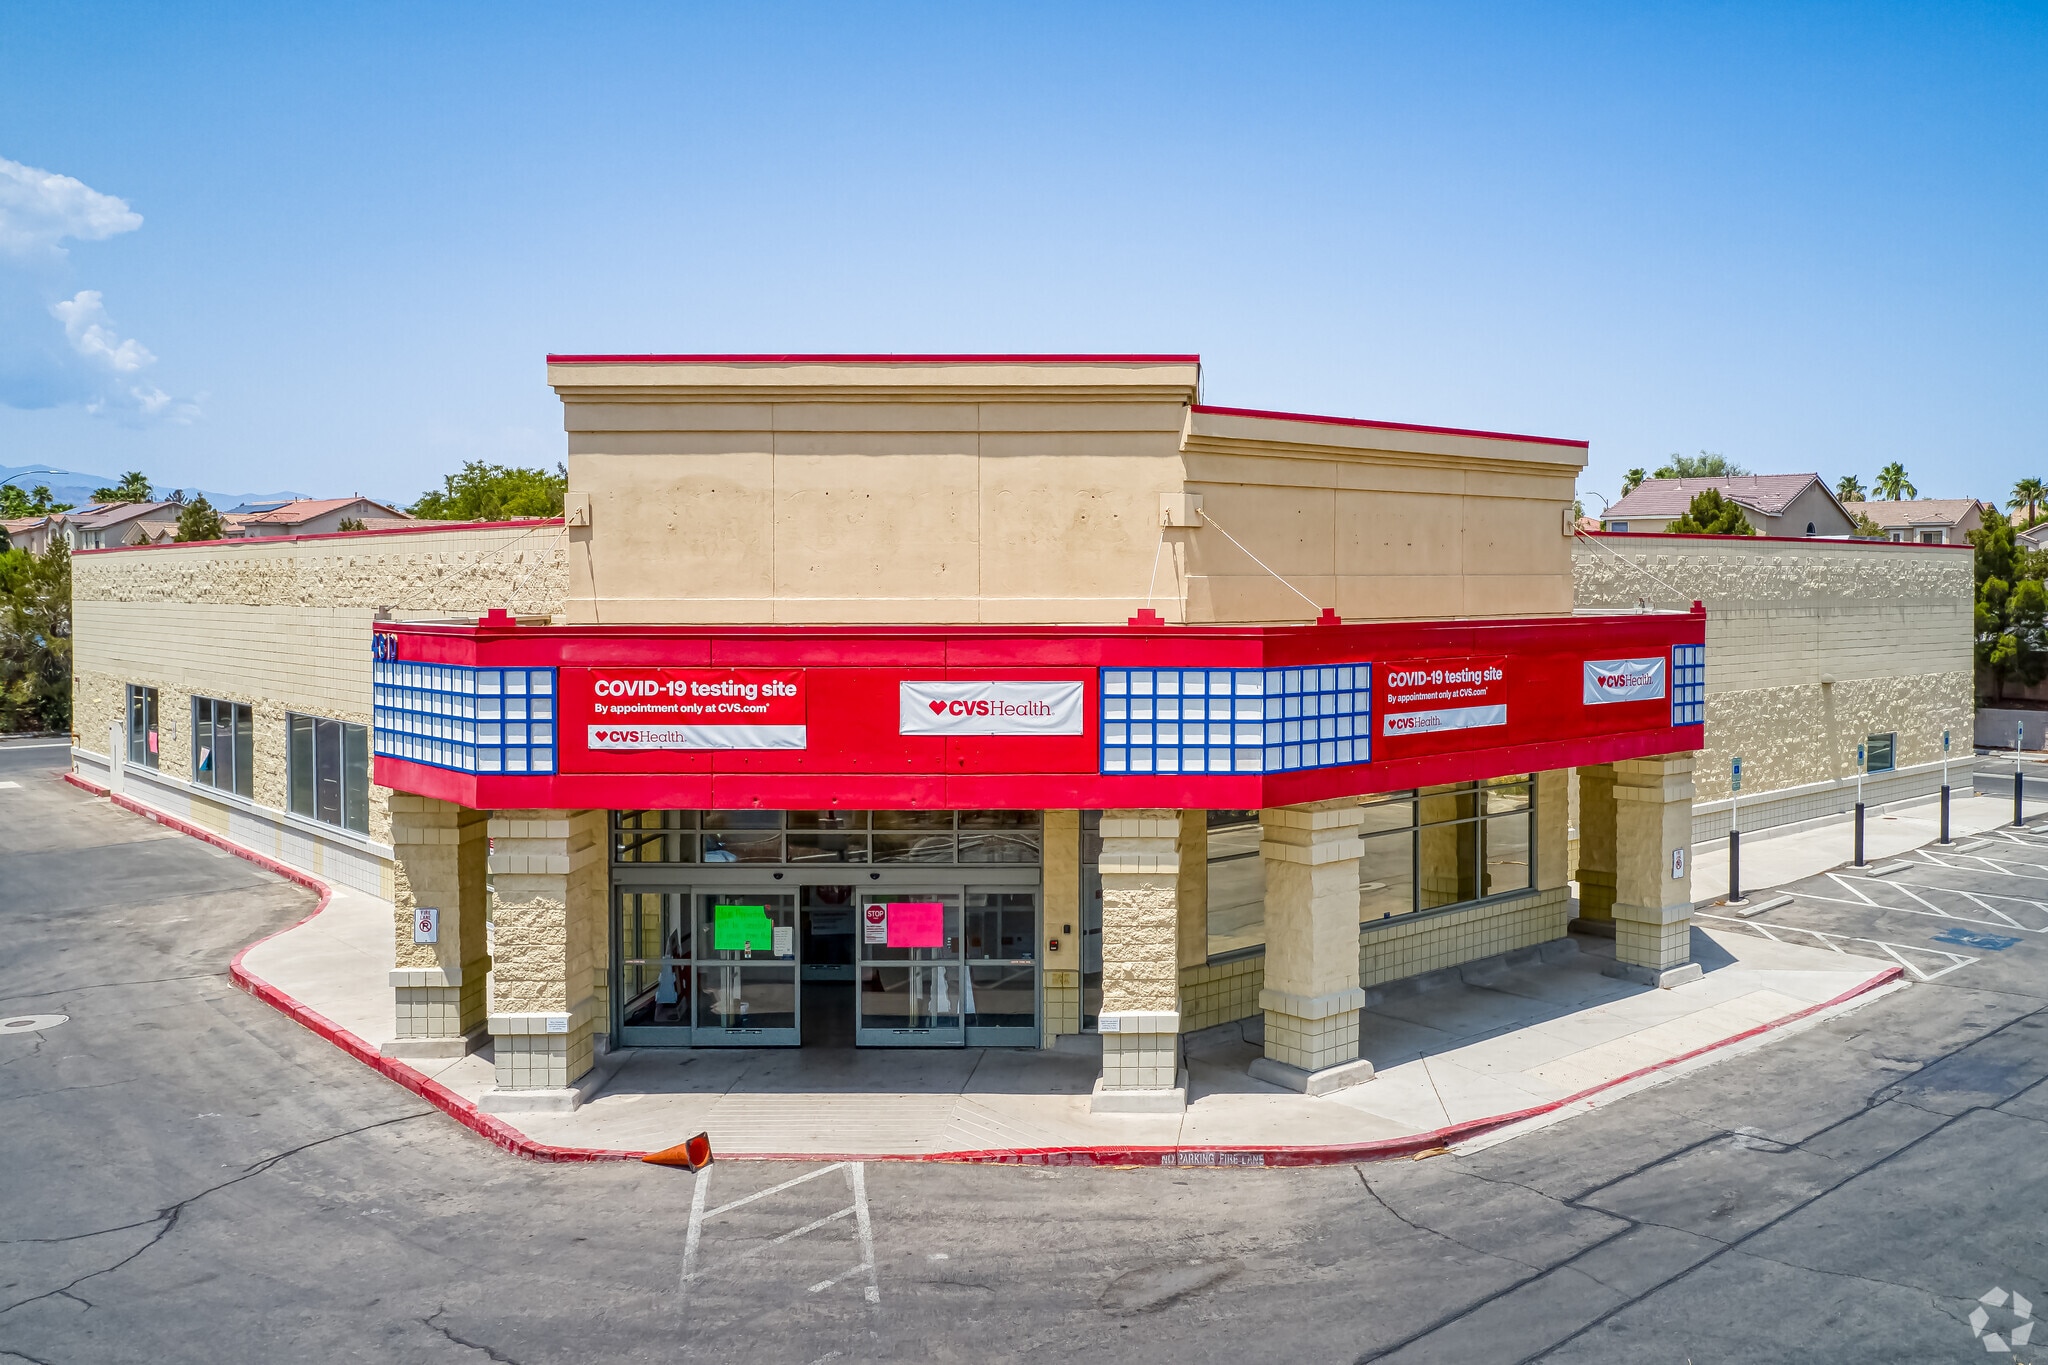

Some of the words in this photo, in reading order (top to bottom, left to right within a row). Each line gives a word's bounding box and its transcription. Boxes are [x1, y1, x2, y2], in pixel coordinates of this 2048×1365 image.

[1388, 669, 1443, 687] COVID-19
[1445, 668, 1482, 685] testing
[1483, 666, 1503, 681] site
[594, 680, 687, 697] COVID-19
[691, 679, 758, 700] testing
[761, 679, 797, 697] site
[1388, 694, 1397, 704] By
[1397, 691, 1438, 704] appointment
[1439, 689, 1451, 700] only
[1452, 690, 1459, 698] at
[594, 703, 608, 715] By
[610, 703, 679, 715] appointment
[680, 703, 703, 715] only
[705, 704, 716, 713] at
[1161, 1154, 1176, 1165] NO
[1179, 1153, 1215, 1165] PARKING
